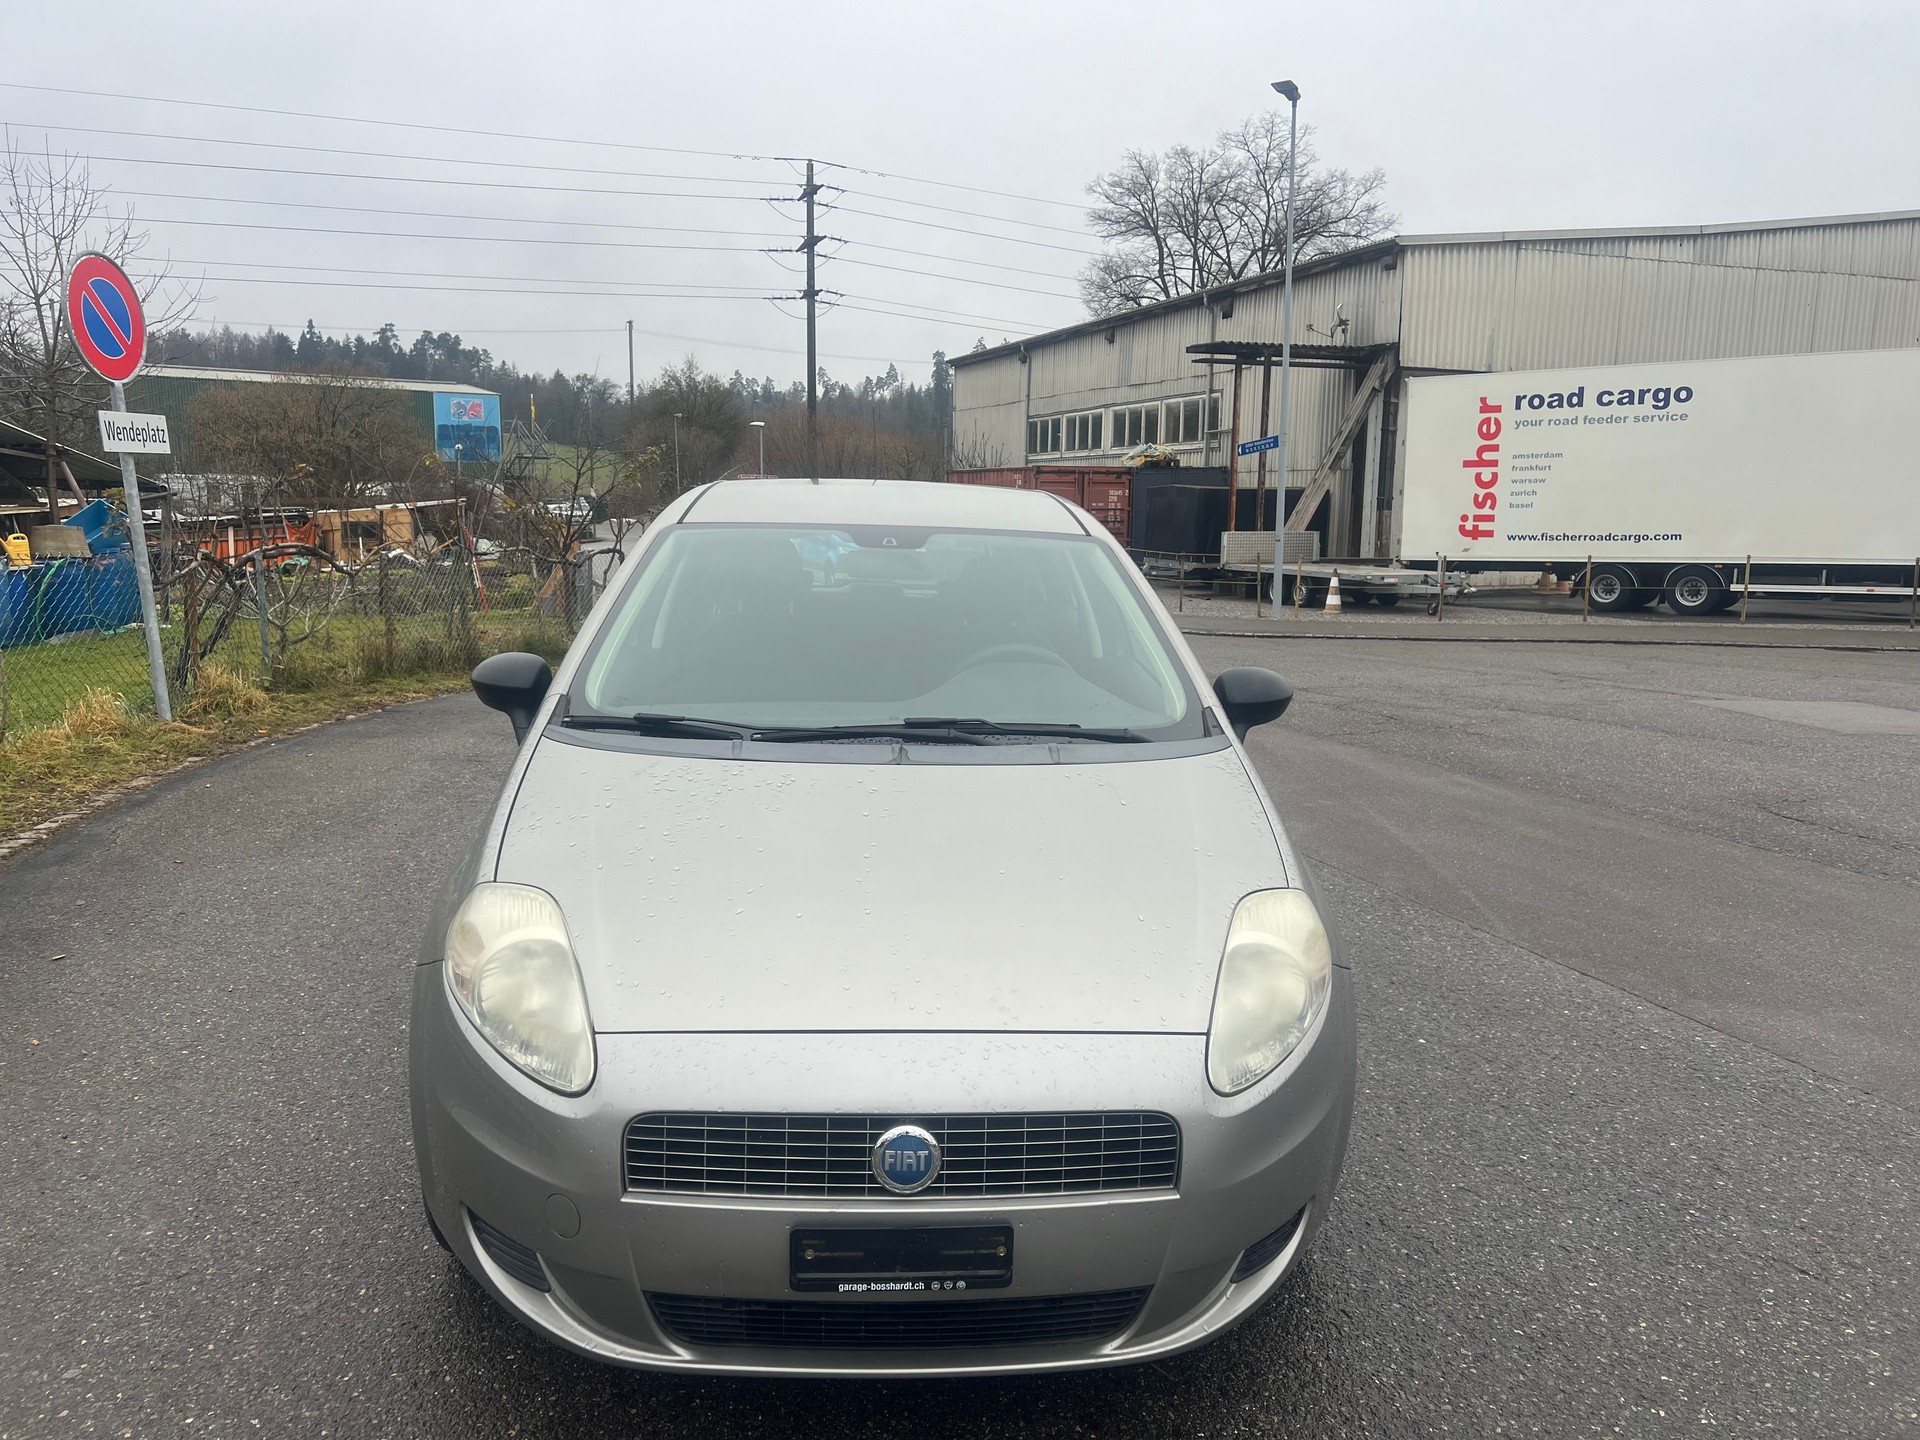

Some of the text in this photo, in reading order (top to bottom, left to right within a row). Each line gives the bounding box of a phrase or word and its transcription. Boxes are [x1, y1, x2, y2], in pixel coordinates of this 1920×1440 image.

[1514, 386, 1694, 411] road cargo
[1514, 411, 1688, 430] your road feeder service
[104, 420, 167, 448] Wendeplatz
[1512, 451, 1563, 460] amsterdam
[1458, 396, 1502, 540] fischer
[1511, 464, 1552, 472] frankfurt
[1510, 489, 1537, 497] zurich
[1507, 532, 1682, 544] www.fischerroadcargo.com
[884, 1150, 929, 1171] FIAT
[838, 1281, 925, 1293] garage-bosshardt.ch
